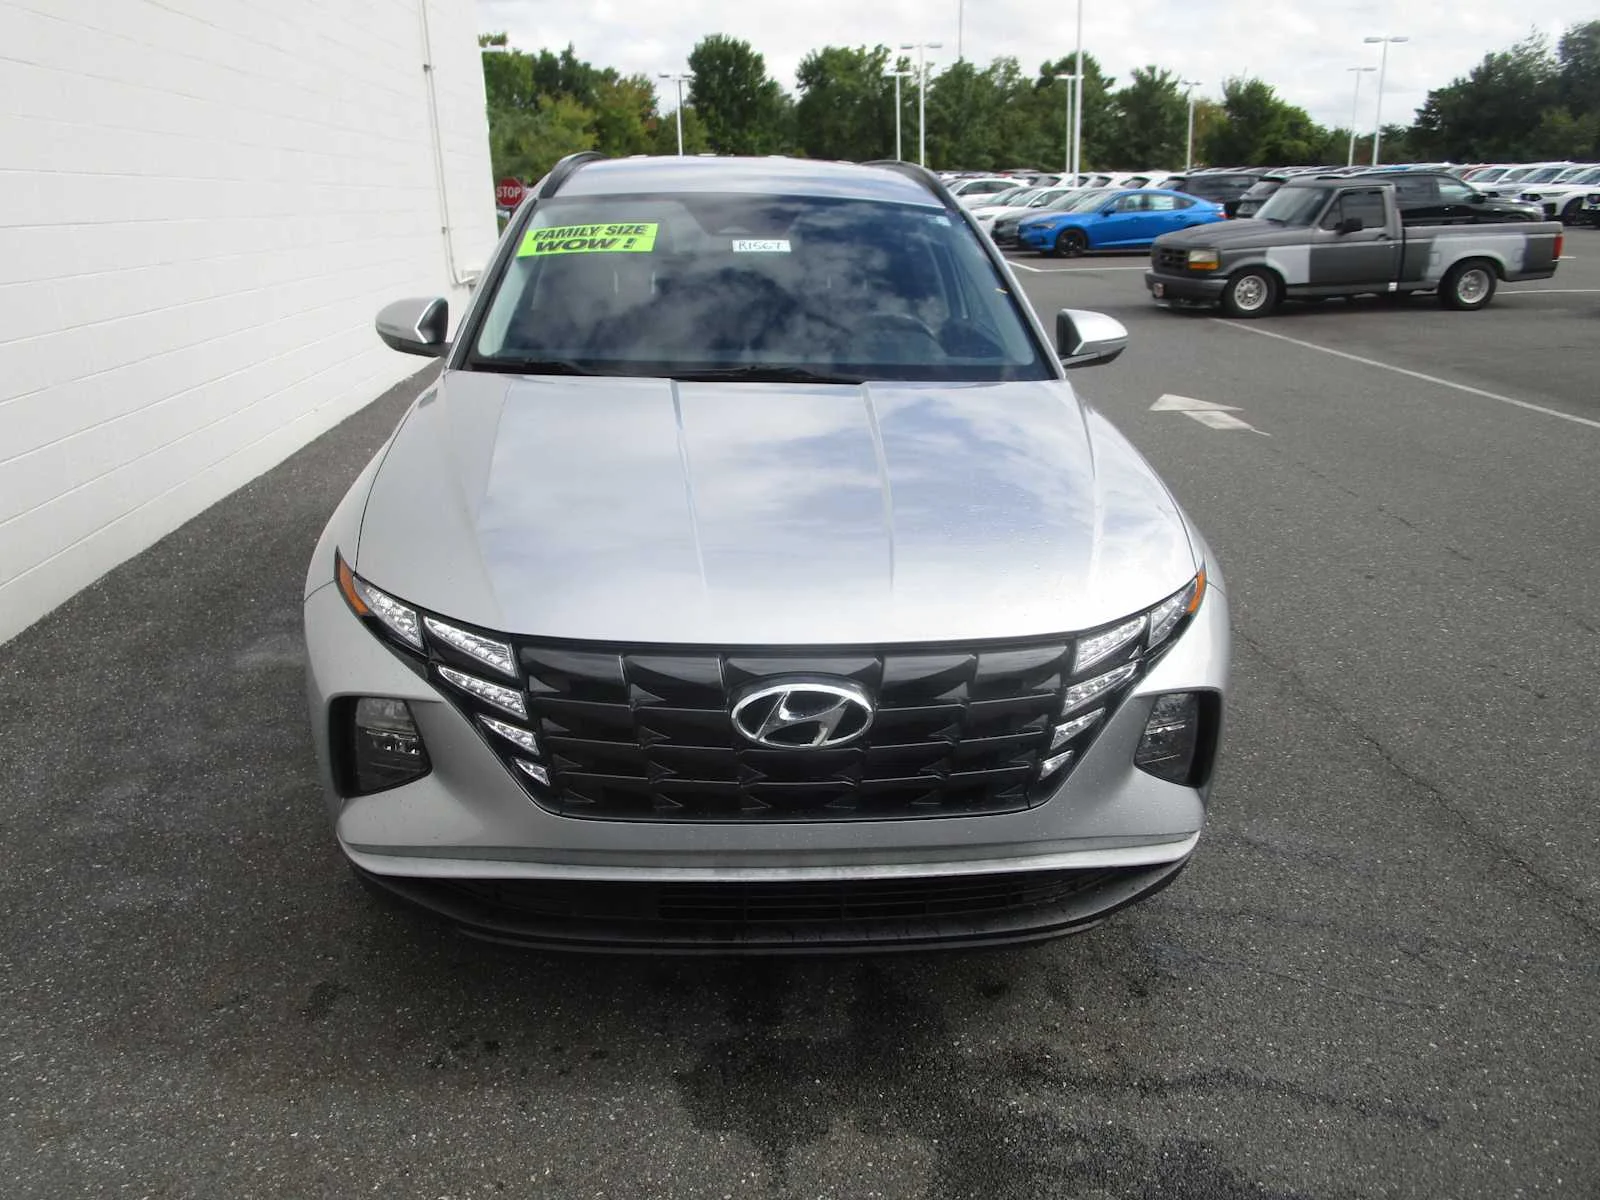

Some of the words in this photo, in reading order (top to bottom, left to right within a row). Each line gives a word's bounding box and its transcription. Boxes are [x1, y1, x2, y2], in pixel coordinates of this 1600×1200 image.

[496, 186, 521, 199] STOP
[533, 226, 600, 241] FAMILY
[605, 224, 647, 236] SIZE
